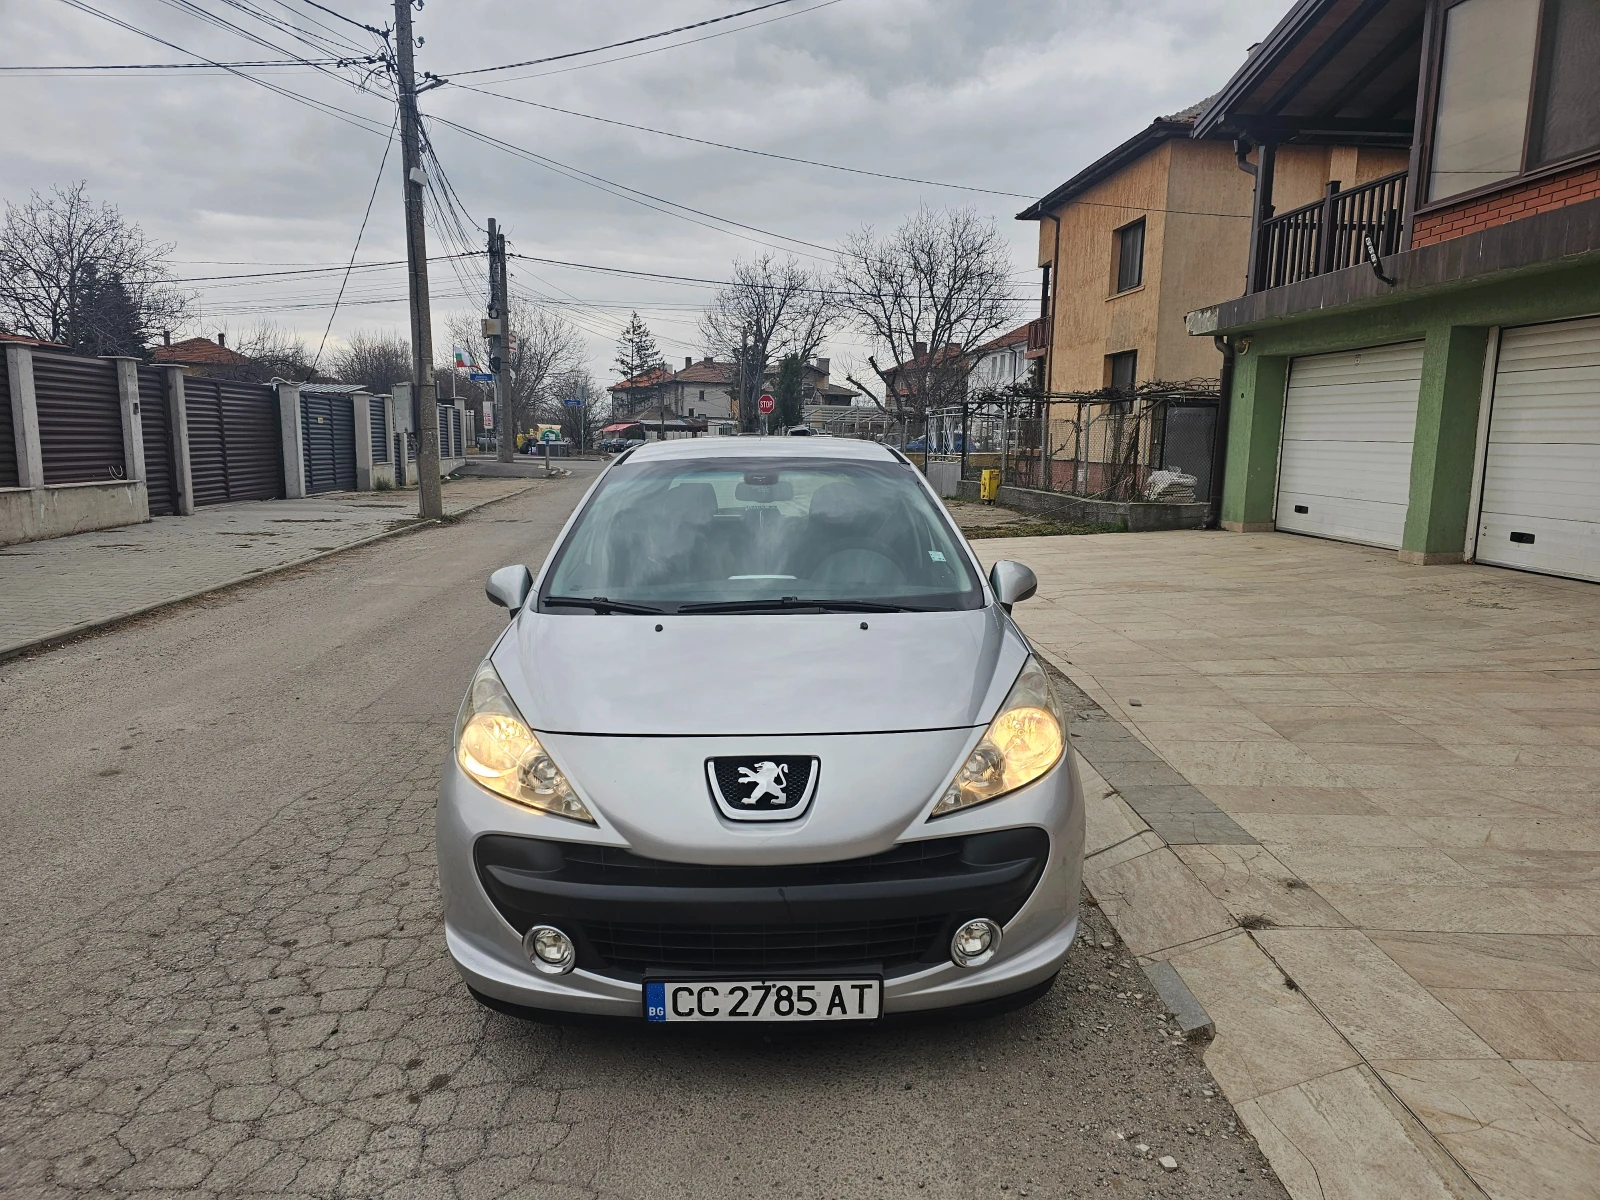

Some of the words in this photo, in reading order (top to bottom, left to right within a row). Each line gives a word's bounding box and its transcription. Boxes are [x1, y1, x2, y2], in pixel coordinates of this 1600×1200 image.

[760, 400, 773, 408] STOP
[671, 986, 720, 1017] CC
[728, 984, 818, 1017] 2785
[826, 983, 873, 1016] AT
[648, 1006, 665, 1017] BG
